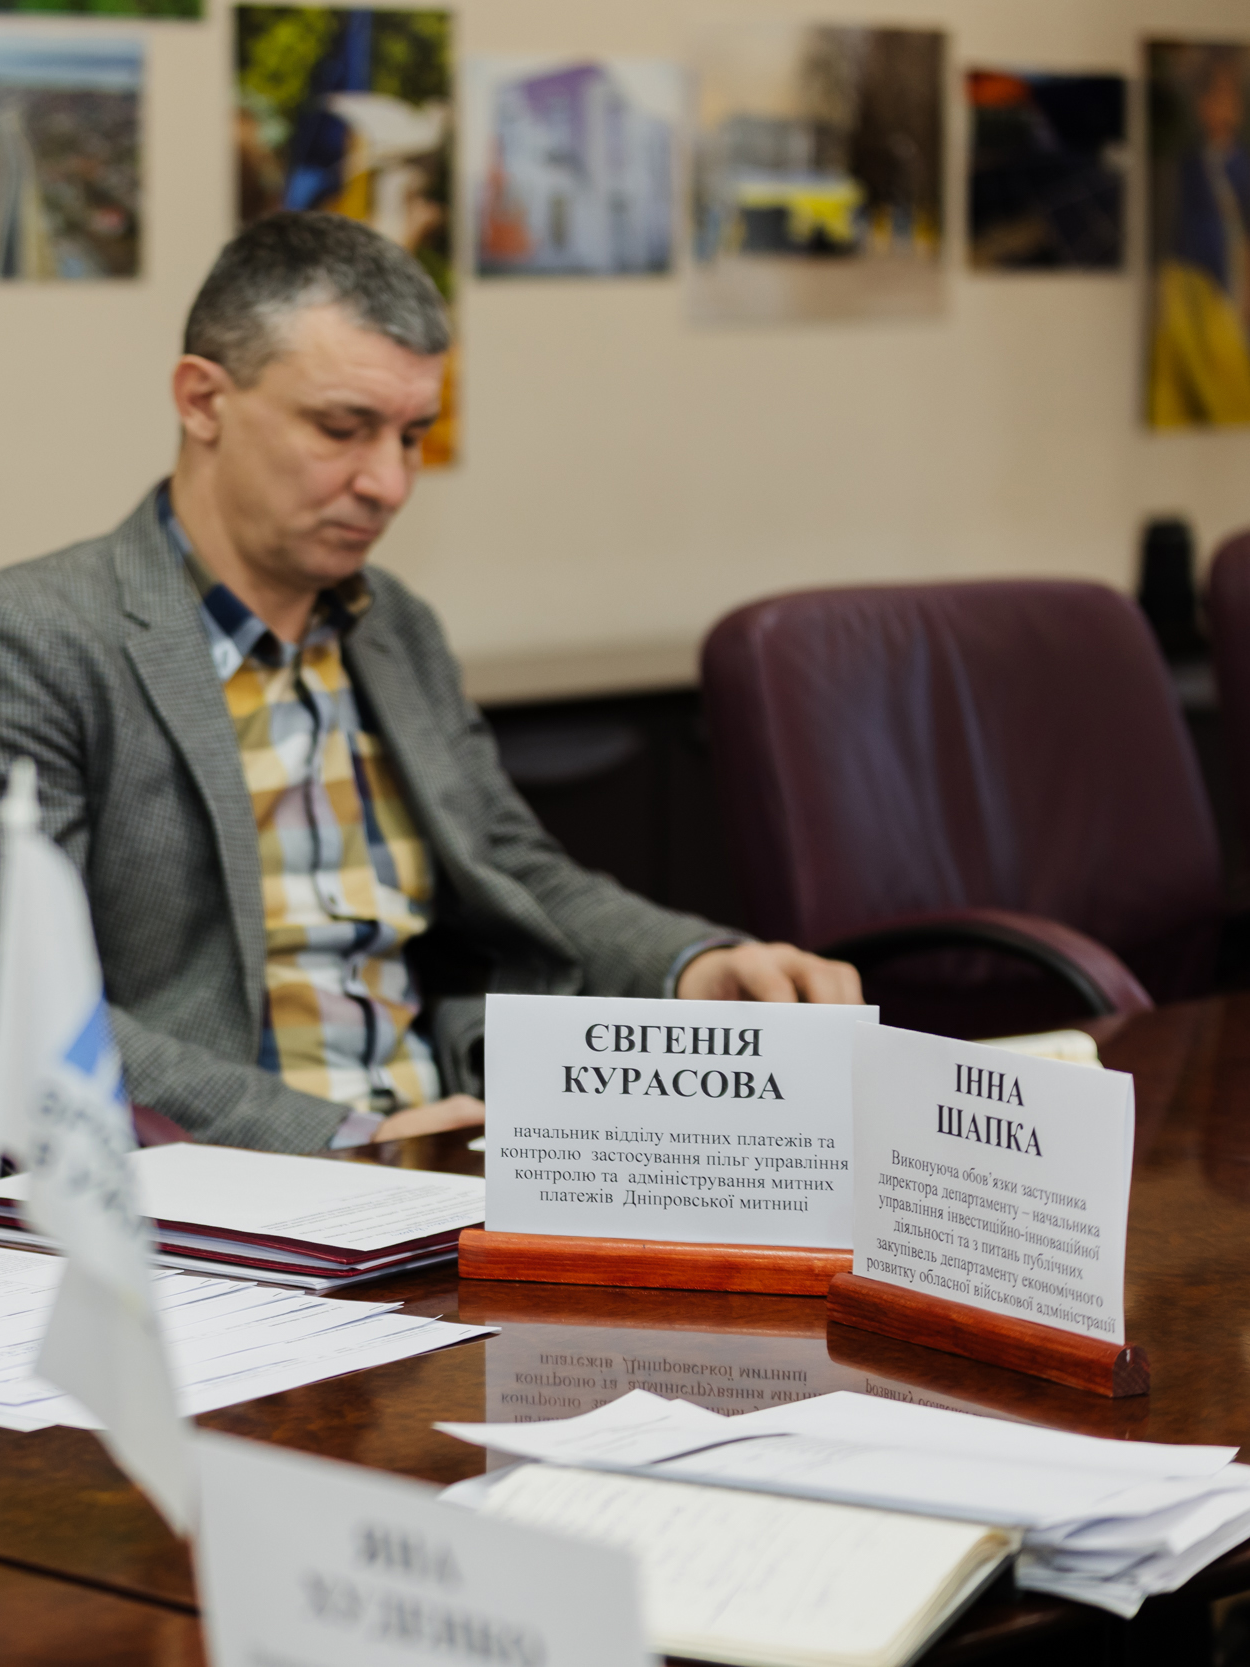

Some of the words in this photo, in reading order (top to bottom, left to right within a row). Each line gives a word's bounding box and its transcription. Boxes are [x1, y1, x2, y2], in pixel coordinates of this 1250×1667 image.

[585, 1023, 763, 1057] ЄВГЕНІЯ
[561, 1065, 785, 1100] КУРАСОВА
[954, 1063, 1025, 1107] ІННА
[513, 1126, 600, 1141] начальник
[605, 1126, 664, 1146] відділу
[669, 1132, 731, 1146] митних
[737, 1133, 812, 1148] платежів
[817, 1137, 835, 1149] та
[936, 1104, 1043, 1157] ШАПКА
[500, 1146, 581, 1163] контролю
[591, 1150, 701, 1167] застосування
[706, 1151, 750, 1167] пільг
[754, 1155, 849, 1172] управління
[514, 1168, 596, 1184] контролю
[601, 1172, 618, 1183] та
[628, 1170, 765, 1190] адміністрування
[771, 1178, 835, 1191] митних
[891, 1149, 960, 1179] Виконуюча
[1021, 1183, 1087, 1211] заступника
[539, 1189, 614, 1204] платежів
[623, 1190, 735, 1210] Дніпровської
[740, 1196, 809, 1212] митниці
[878, 1173, 938, 1198] директора
[941, 1187, 1019, 1220] департаменту
[1032, 1210, 1100, 1237] начальника
[878, 1194, 944, 1220] управління
[947, 1206, 1100, 1261] інвестиційно-інноваційної
[893, 1217, 954, 1245] діяльності
[957, 1236, 970, 1249] та
[972, 1239, 979, 1251] з
[981, 1241, 1020, 1262] питань
[1023, 1252, 1083, 1280] публічних
[866, 1257, 916, 1283] розвитку
[919, 1269, 971, 1294] обласної
[973, 1281, 1033, 1311] військової
[1036, 1303, 1117, 1334] адміністрації
[876, 1237, 937, 1263] закупівель
[940, 1254, 1019, 1288] департаменту
[1021, 1275, 1104, 1308] економічного
